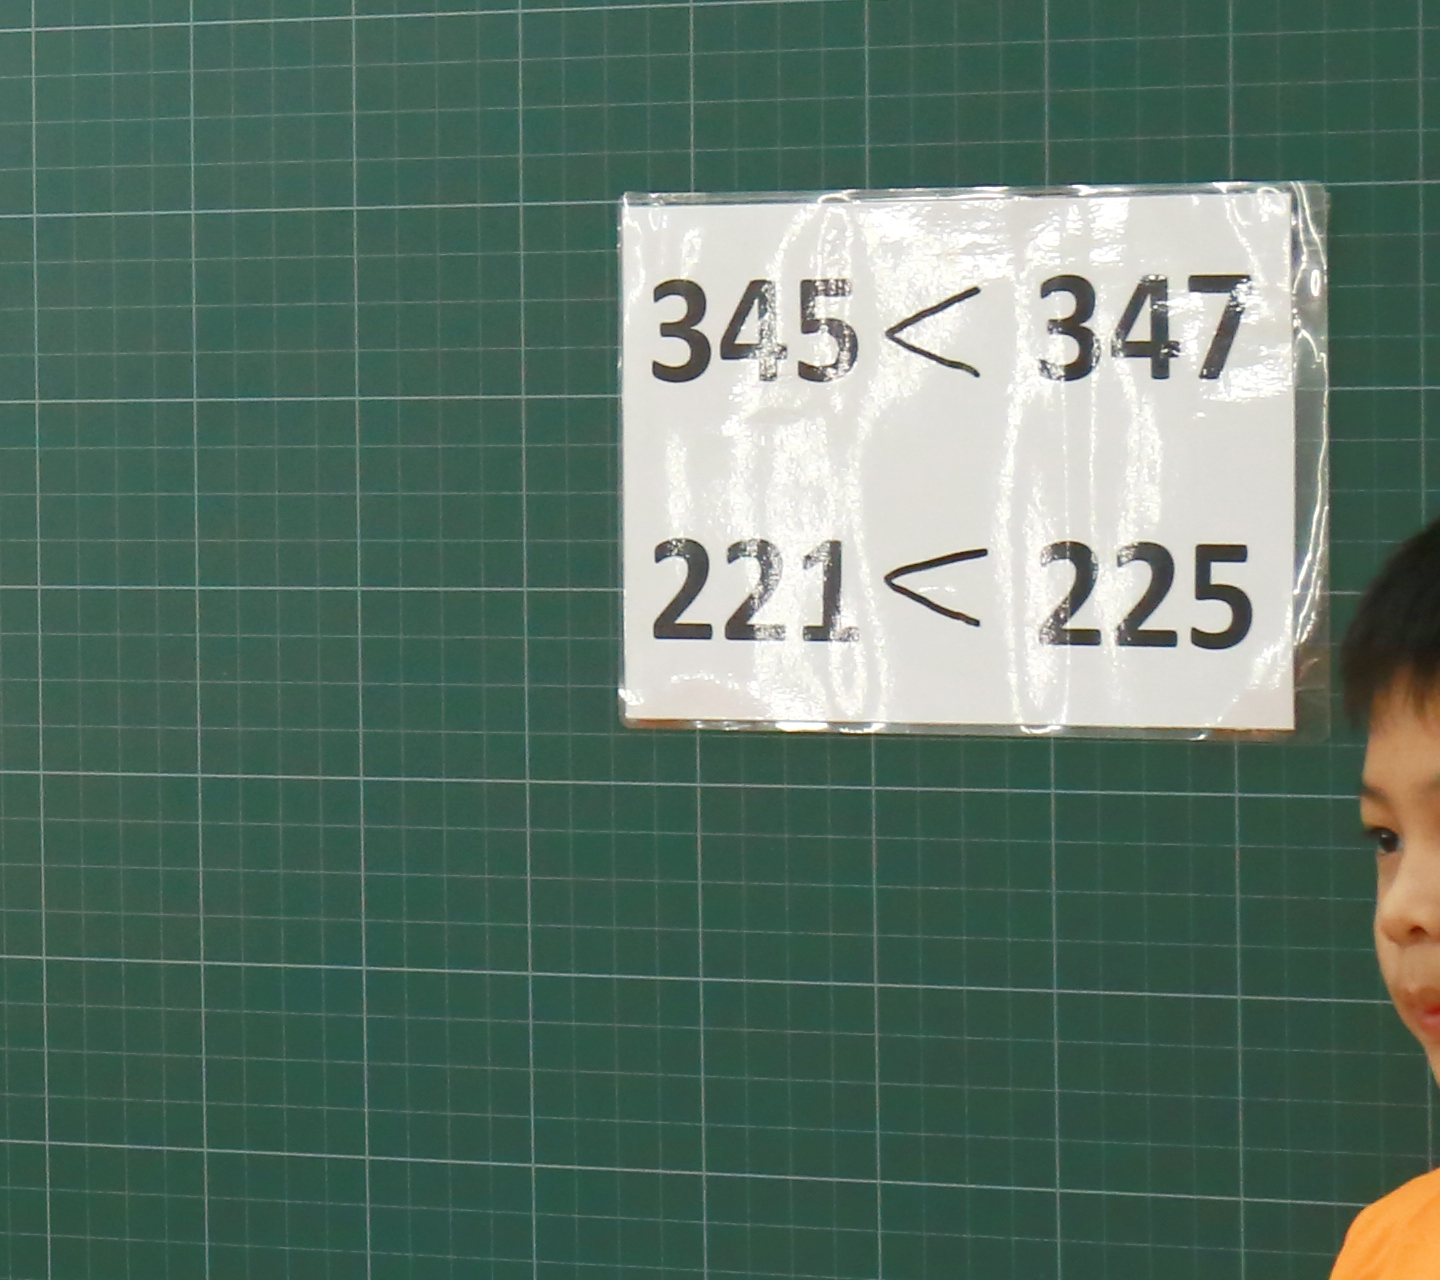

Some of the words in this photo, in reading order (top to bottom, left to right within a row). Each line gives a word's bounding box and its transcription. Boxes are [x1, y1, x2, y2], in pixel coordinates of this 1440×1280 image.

[650, 278, 860, 383] 345
[1037, 274, 1254, 382] 347
[651, 538, 861, 643] 221
[1037, 542, 1255, 651] 225
